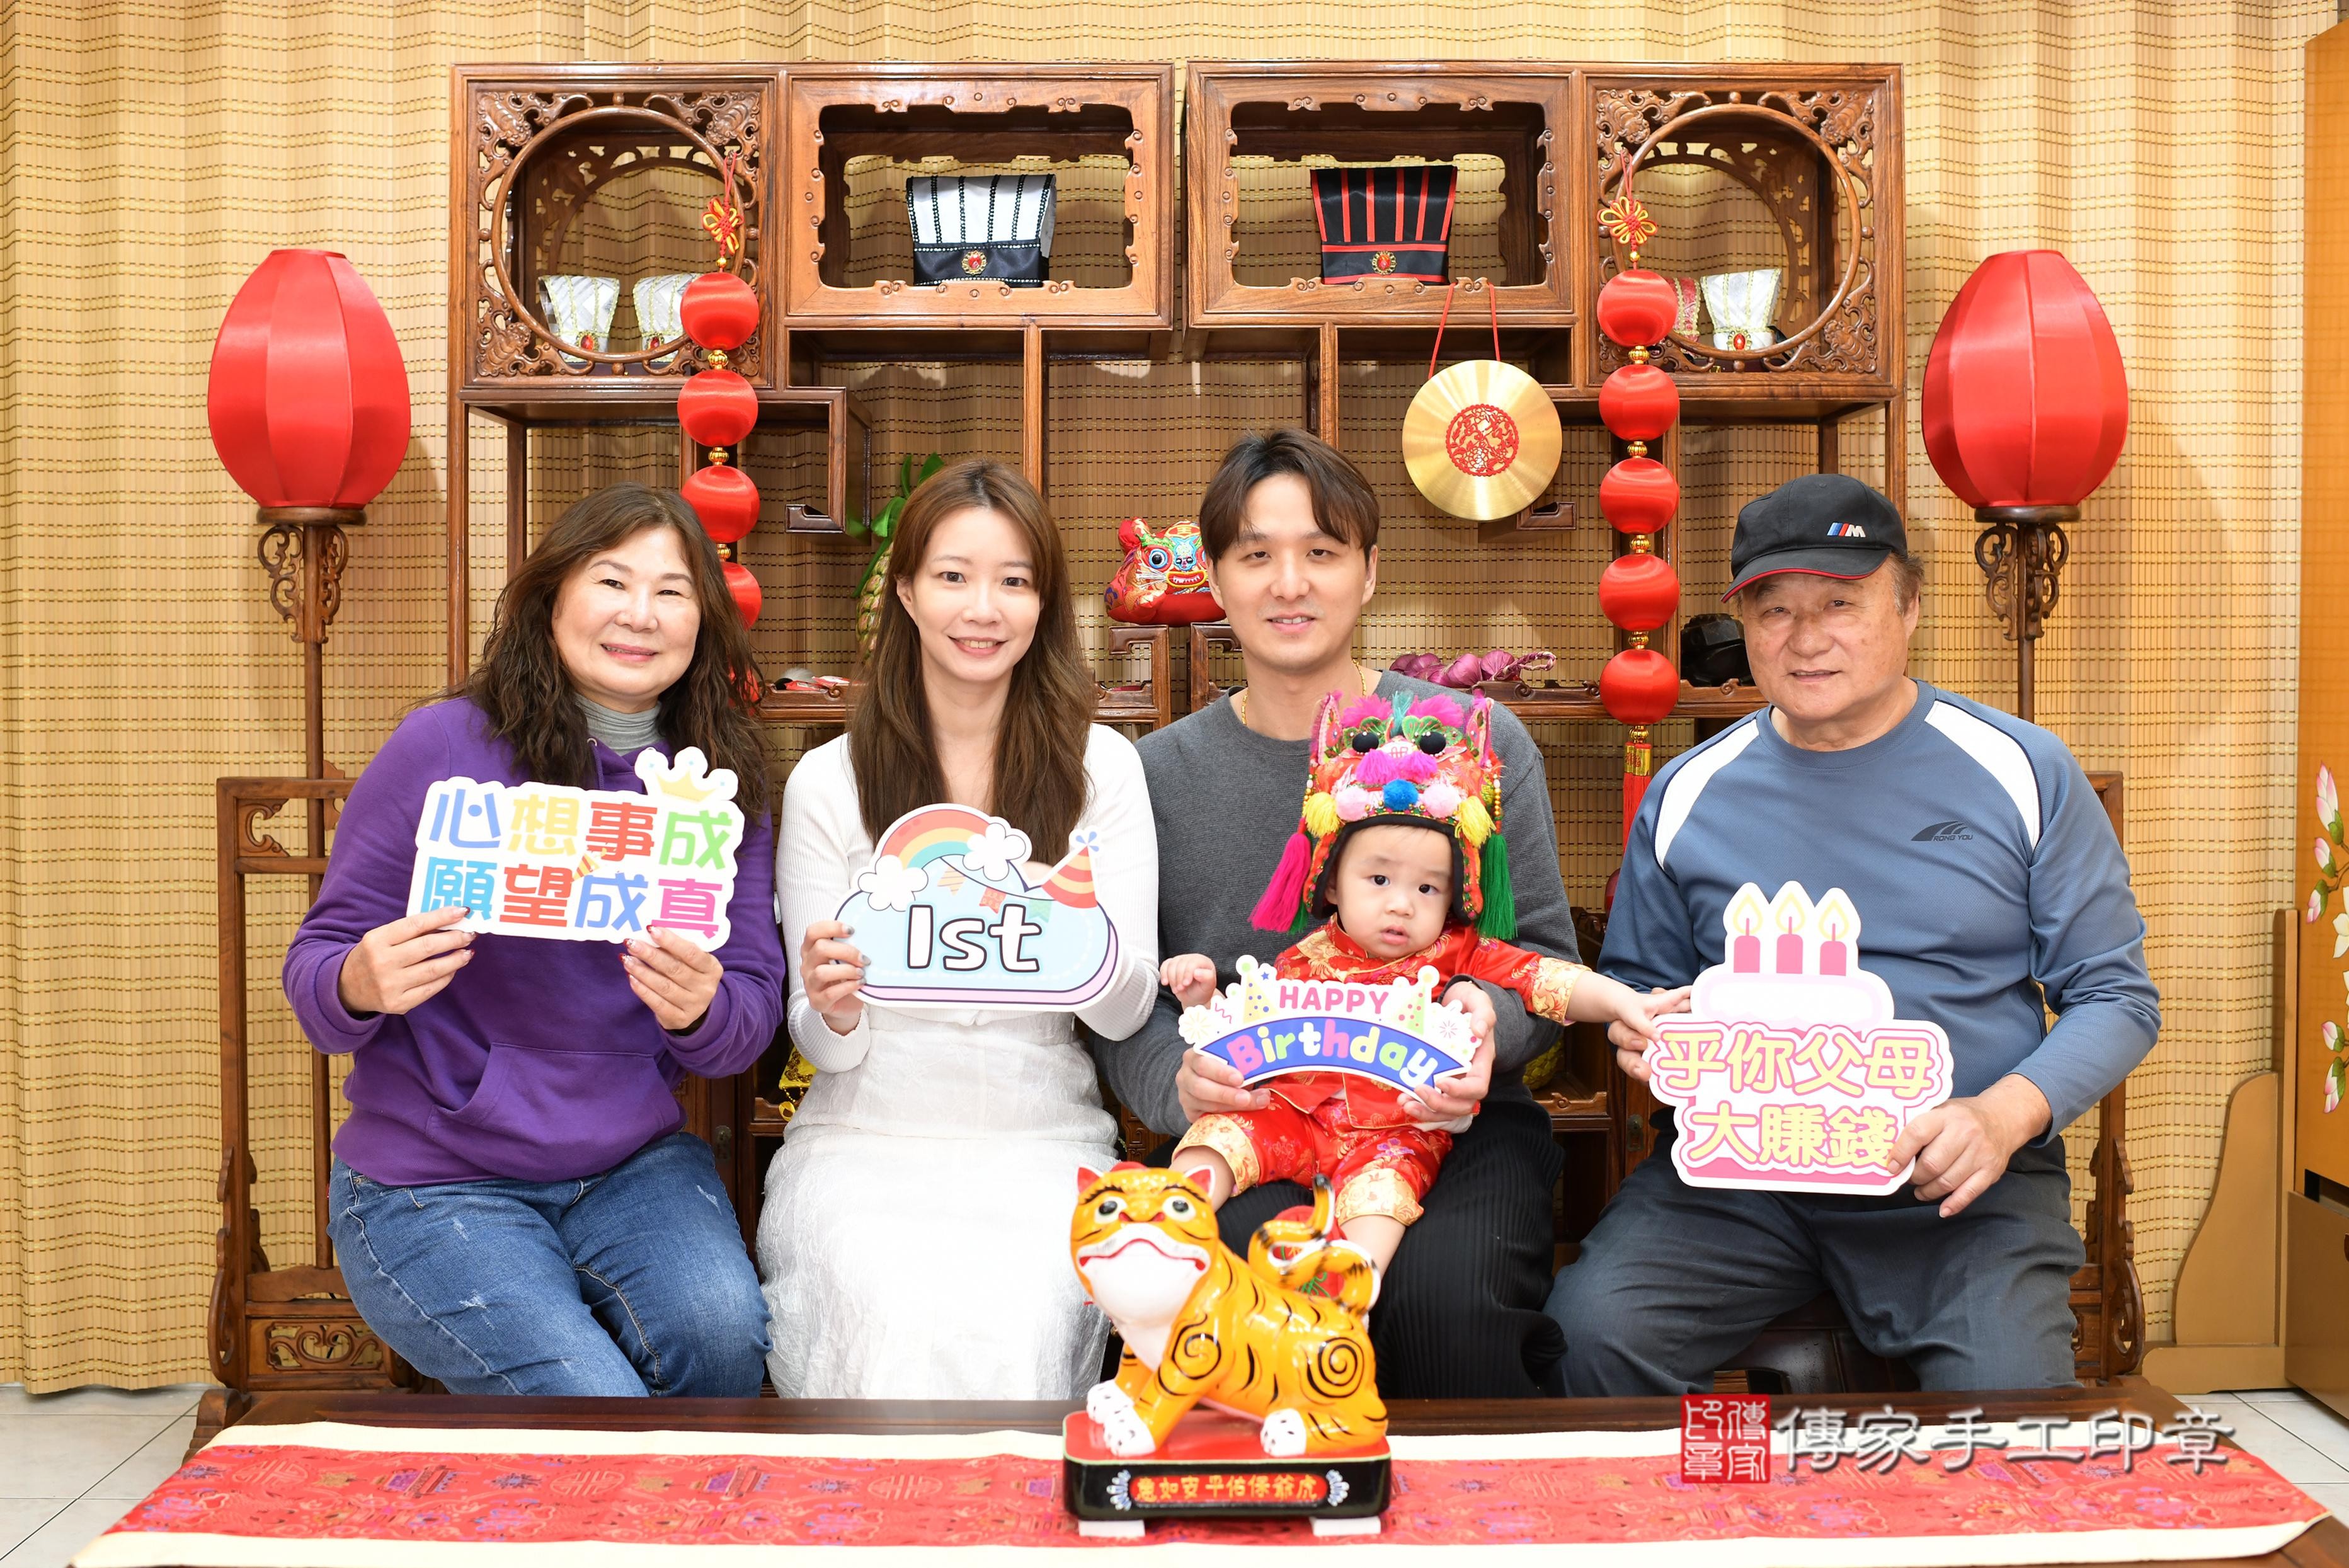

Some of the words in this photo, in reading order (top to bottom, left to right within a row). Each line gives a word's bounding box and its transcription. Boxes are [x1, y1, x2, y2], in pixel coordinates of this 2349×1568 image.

[428, 787, 732, 871] 心想事成
[421, 856, 723, 939] 願望成真
[1279, 985, 1389, 1014] HAPPY
[1226, 1019, 1439, 1087] Birthday
[1658, 1029, 1935, 1099] 乎你父母
[1689, 1100, 1896, 1169] 大賺錢
